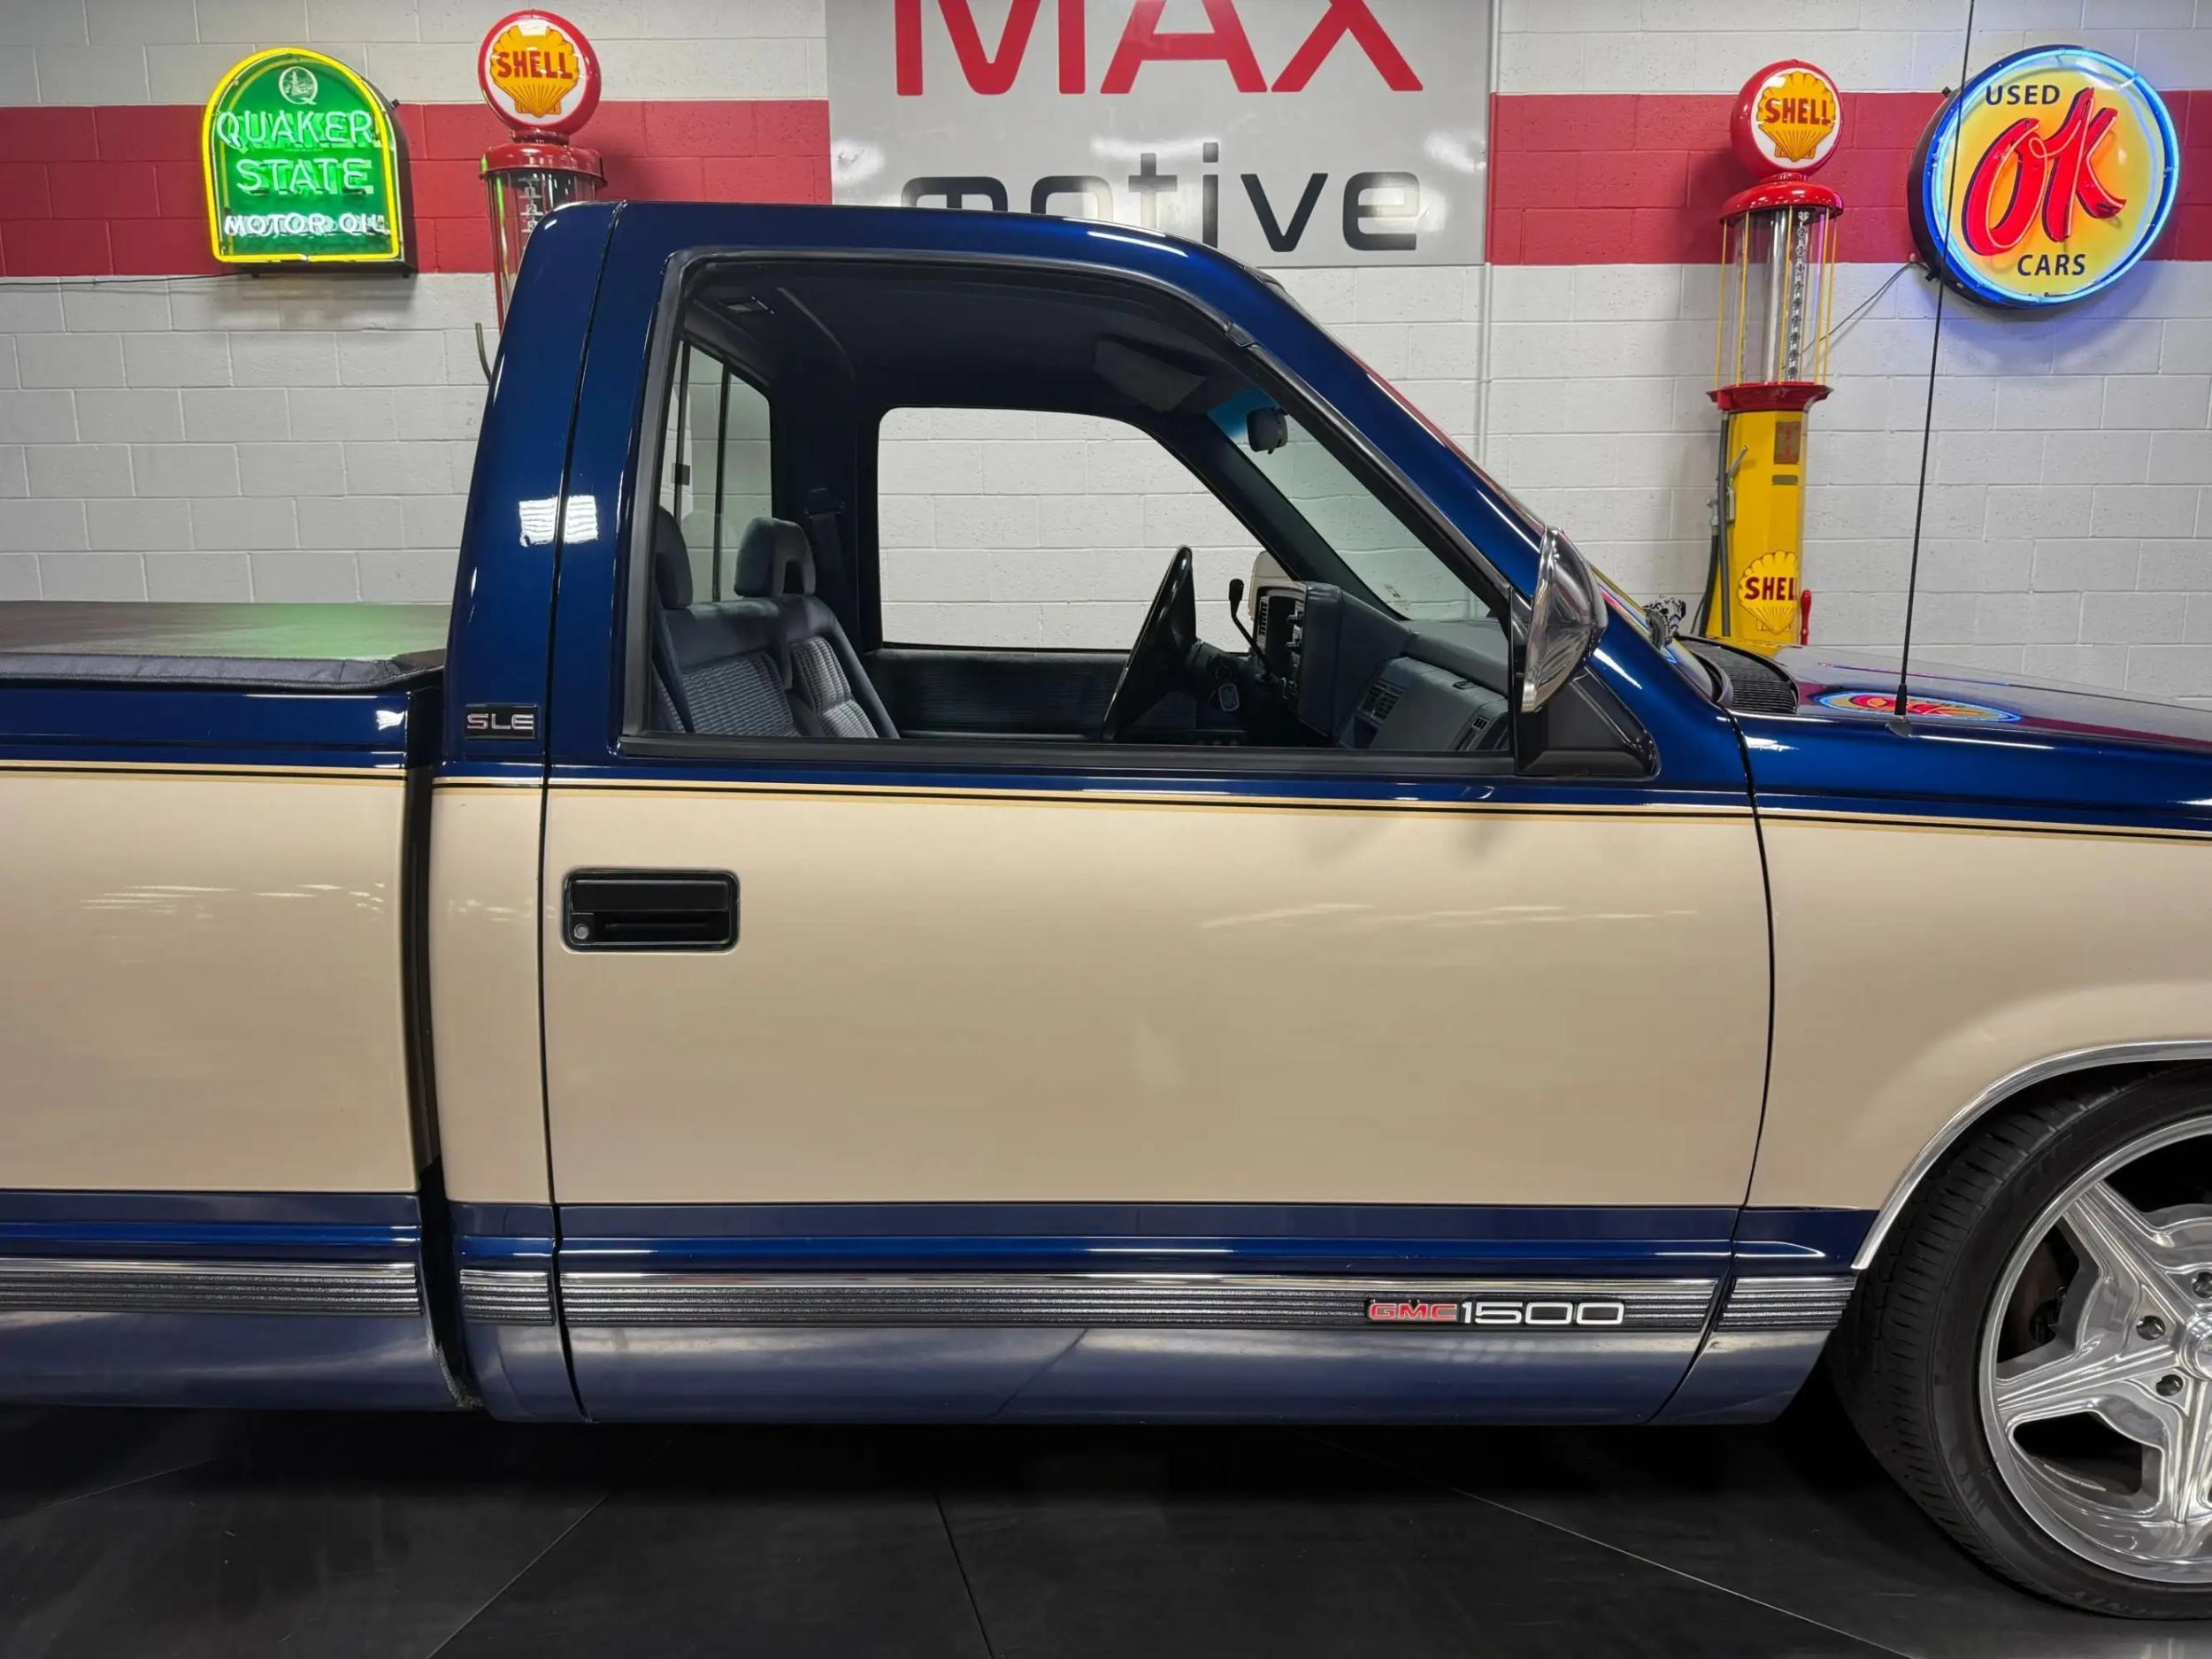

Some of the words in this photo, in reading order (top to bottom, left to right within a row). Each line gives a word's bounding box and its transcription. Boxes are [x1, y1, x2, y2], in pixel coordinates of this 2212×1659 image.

[496, 50, 573, 80] SHELL
[1985, 84, 2061, 105] USED
[1764, 96, 1832, 126] SHELL
[217, 109, 380, 153] QUAKER
[236, 157, 373, 195] STATE
[1961, 87, 2127, 257] OK
[224, 211, 331, 238] MOTOR
[338, 211, 389, 236] OIL
[2016, 253, 2086, 276] CARS
[467, 713, 534, 730] SLE
[1370, 1302, 1457, 1322] GMC
[1462, 1301, 1624, 1325] 1500
